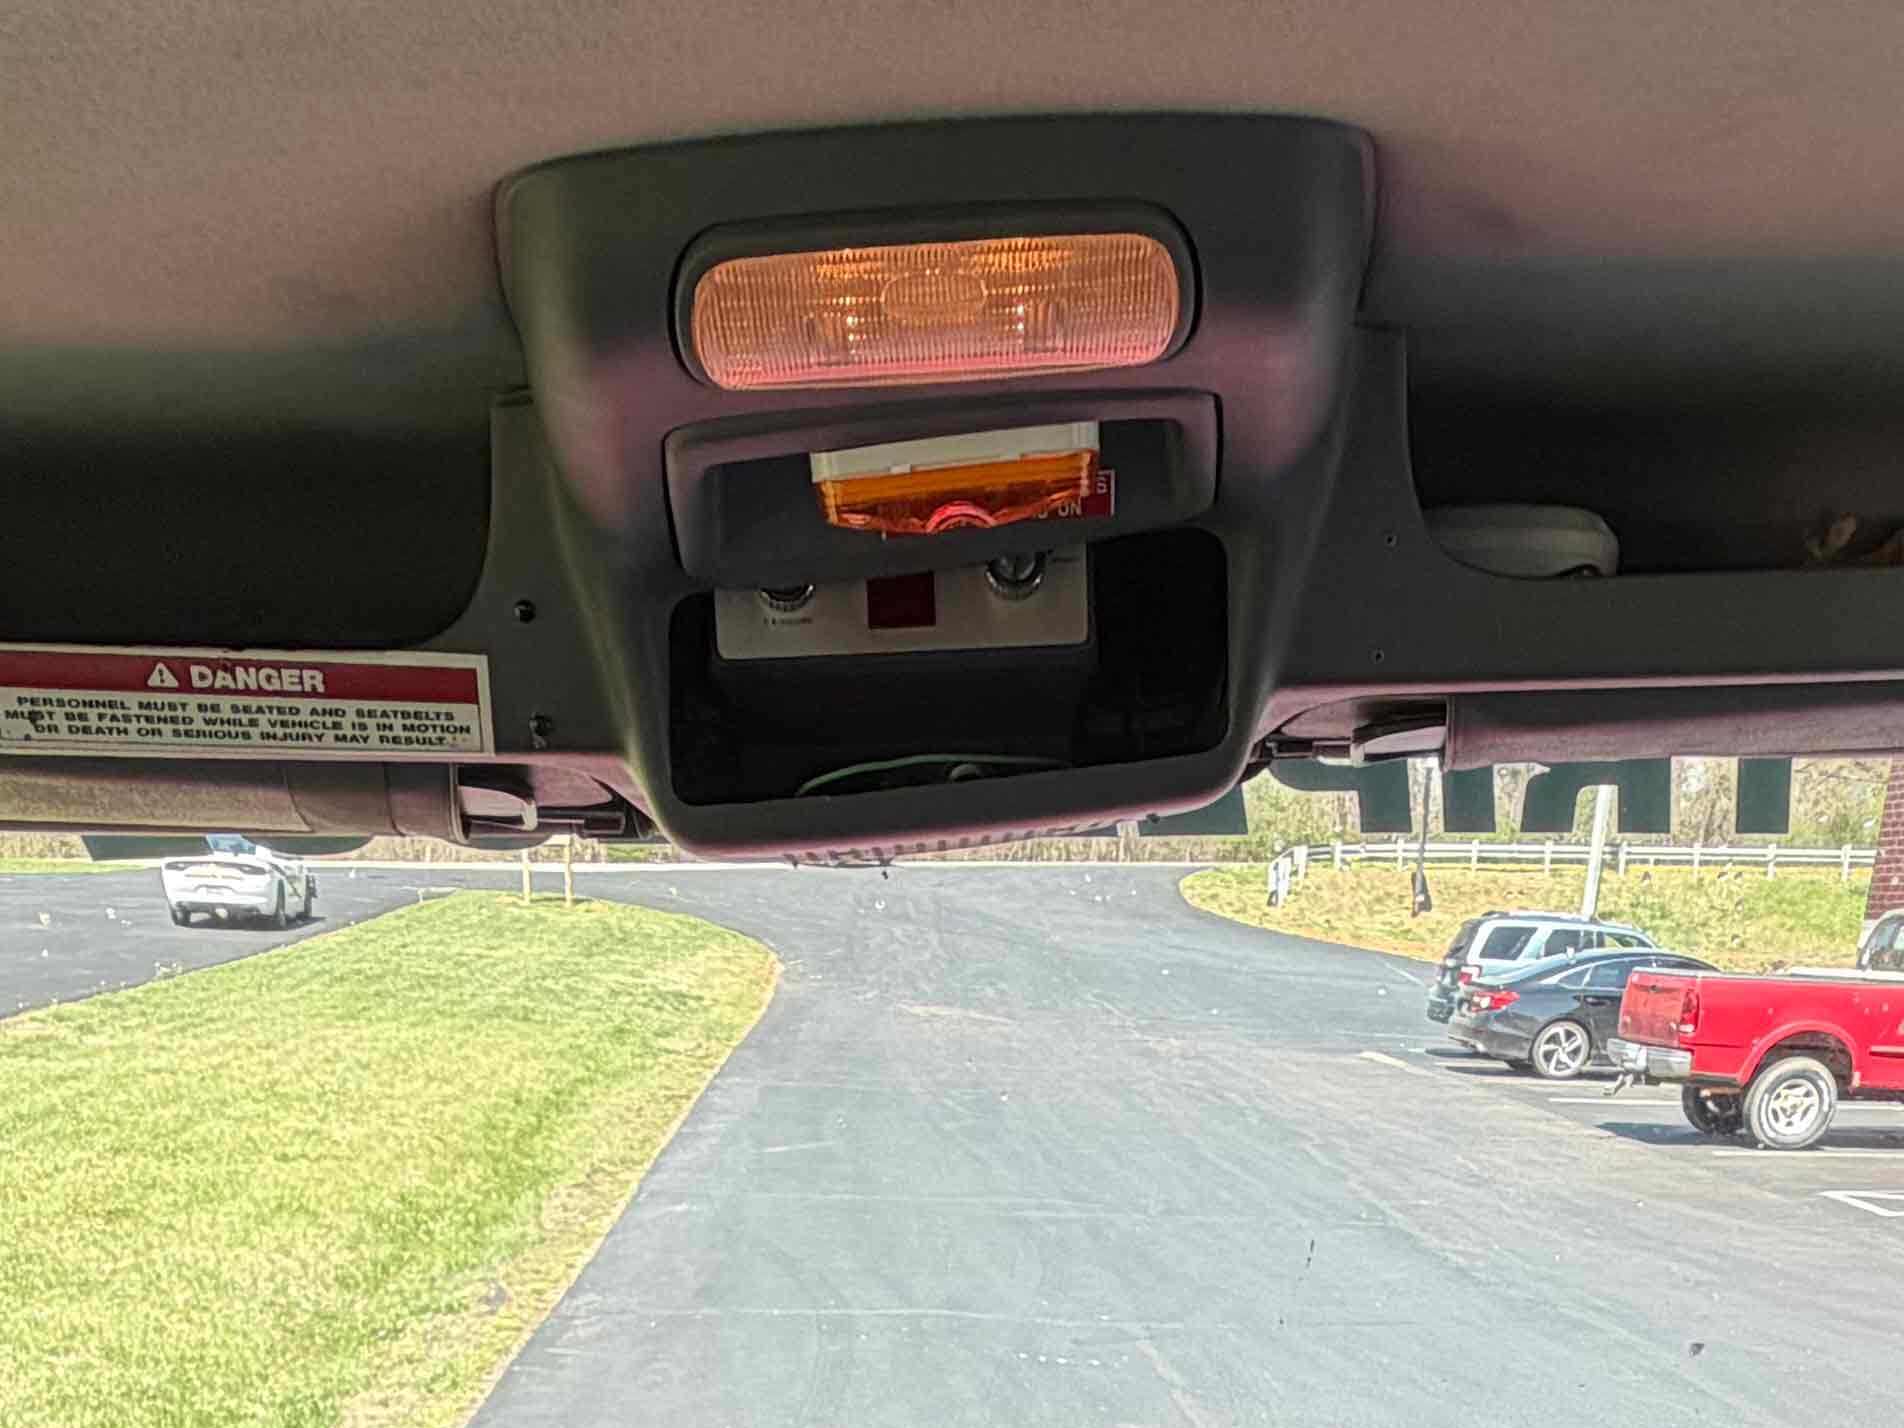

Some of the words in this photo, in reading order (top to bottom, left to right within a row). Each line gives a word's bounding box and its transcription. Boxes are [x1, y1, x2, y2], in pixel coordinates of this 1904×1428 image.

[190, 663, 326, 693] DANGER
[17, 696, 130, 711] PERSONNEL
[138, 701, 189, 712] MUST
[197, 703, 221, 713] BE
[230, 704, 300, 716] SEATED
[309, 707, 347, 718] AND
[355, 709, 455, 721] SEATBELTS
[34, 723, 59, 734] OR
[67, 724, 129, 737] DEATH
[137, 727, 163, 738] OR
[172, 728, 251, 740] SERIOUS
[260, 731, 325, 743] INJURY
[334, 733, 370, 744] MAY
[64, 711, 89, 722] BE
[97, 713, 194, 726] FASTENED
[203, 716, 260, 728] WHILE
[268, 719, 343, 731] VEHICLE
[352, 722, 368, 731] IS
[376, 723, 393, 732] IN
[402, 723, 471, 735] MOTION
